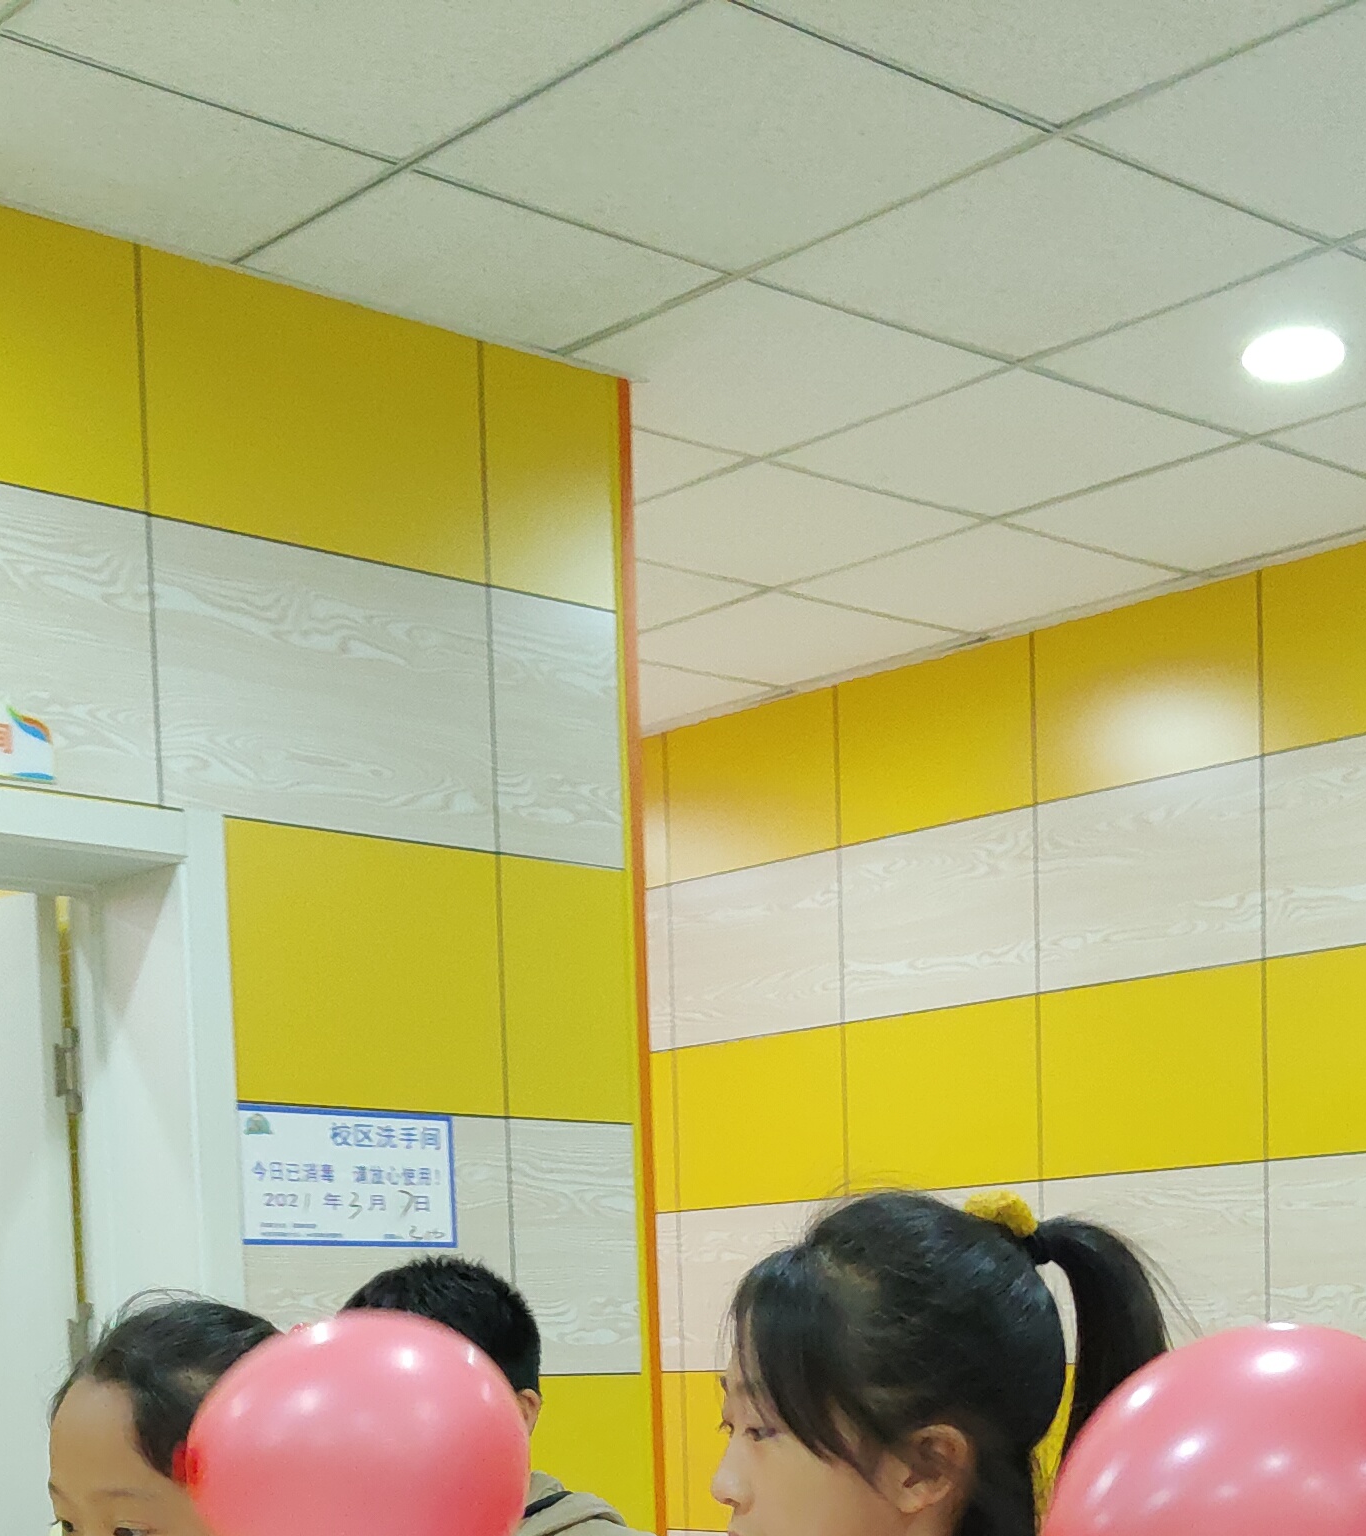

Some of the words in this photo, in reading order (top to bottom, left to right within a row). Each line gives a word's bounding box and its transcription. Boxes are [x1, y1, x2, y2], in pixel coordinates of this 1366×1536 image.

[330, 1122, 442, 1150] 校区洗手间
